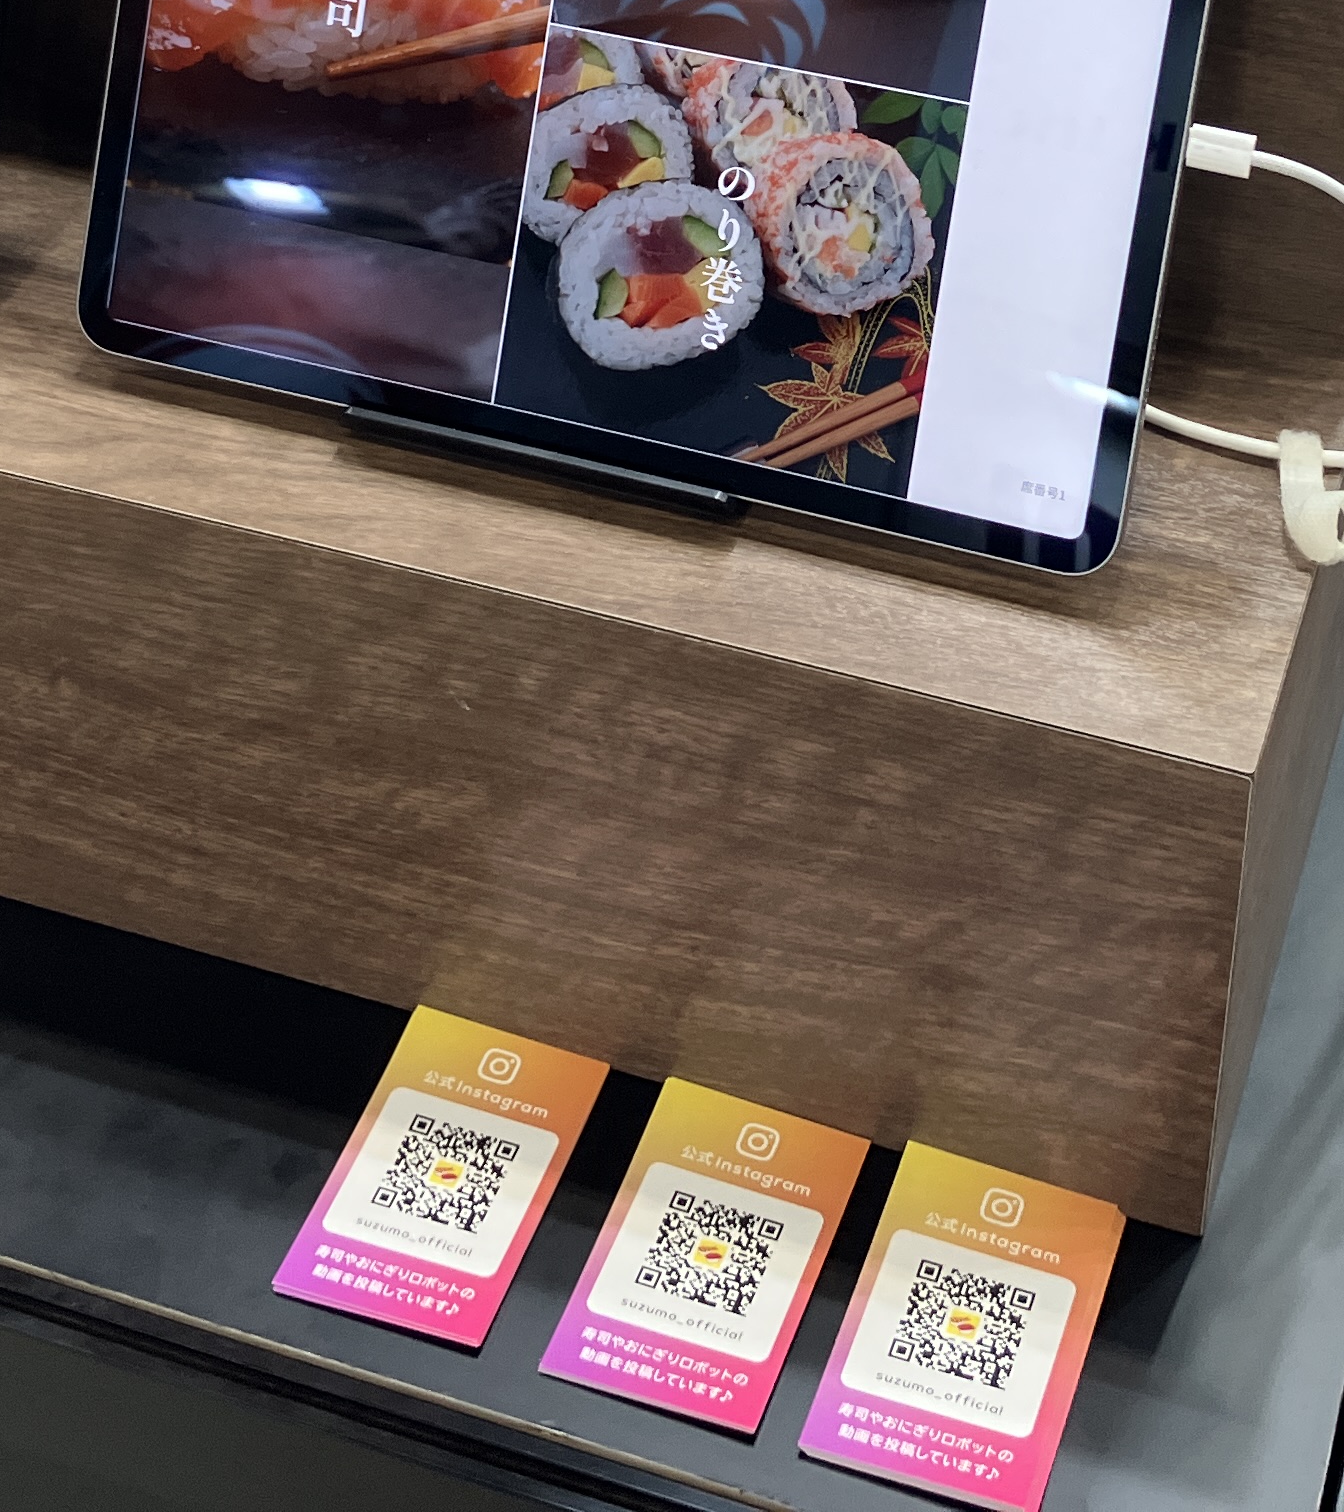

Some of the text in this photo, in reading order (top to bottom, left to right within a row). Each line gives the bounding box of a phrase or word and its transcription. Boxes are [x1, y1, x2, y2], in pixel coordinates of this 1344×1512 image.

[700, 165, 756, 351] のり巻き
[356, 1217, 473, 1258] suzumo_official
[620, 1297, 745, 1342] suzumo_official
[875, 1370, 1004, 1416] suzumo_official
